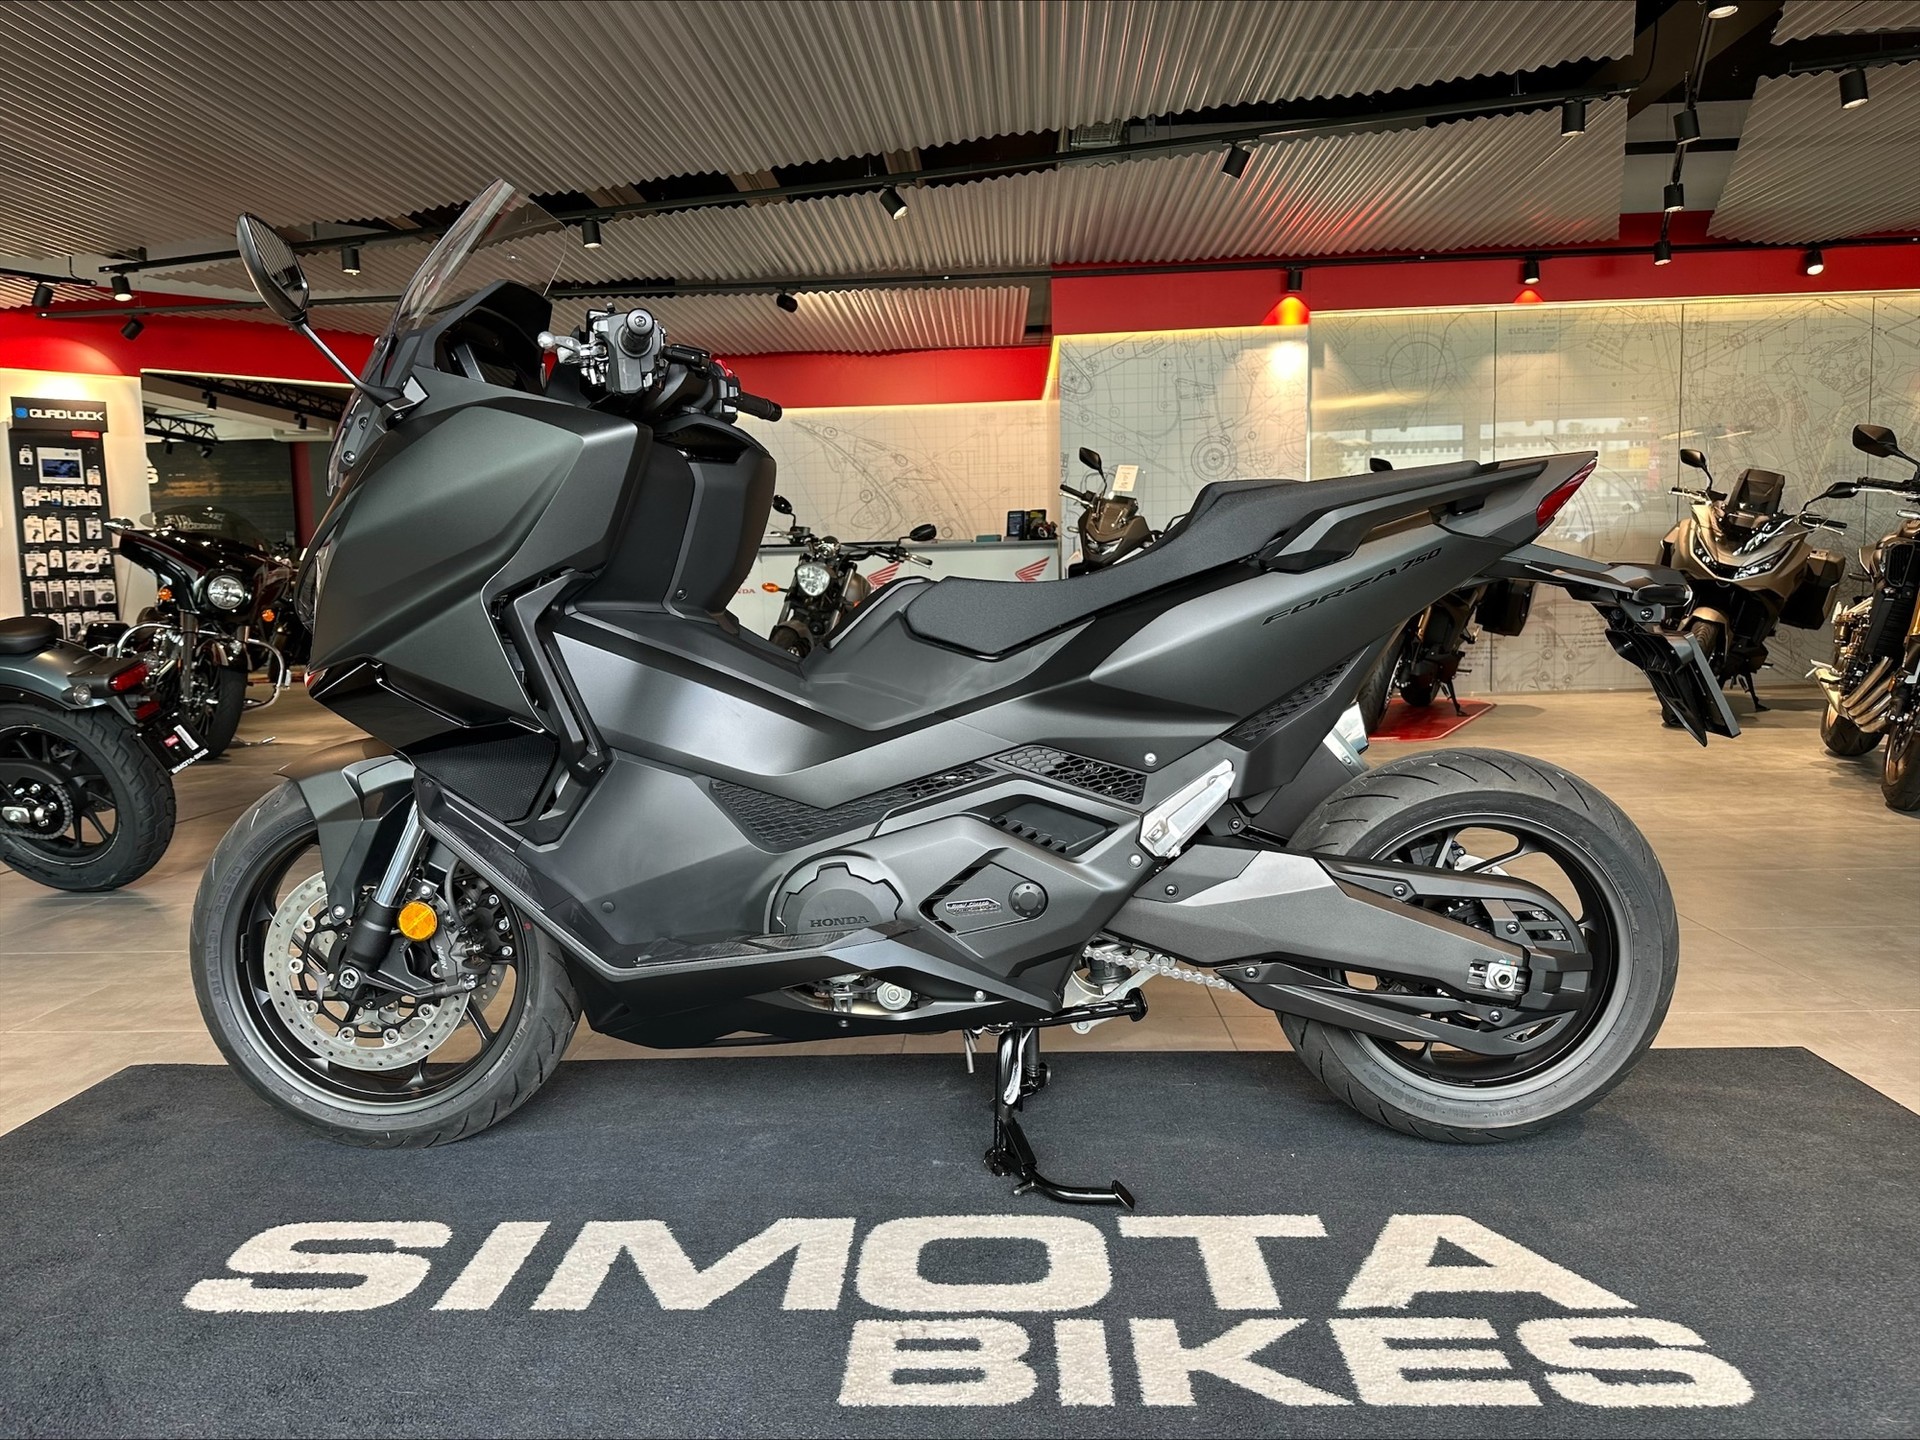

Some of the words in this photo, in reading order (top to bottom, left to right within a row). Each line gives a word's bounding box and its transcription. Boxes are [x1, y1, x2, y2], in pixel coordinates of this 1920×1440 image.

[1262, 567, 1397, 625] FORZA
[1400, 547, 1442, 571] 750
[810, 915, 870, 928] HONDA
[183, 1214, 1637, 1314] SIMOTA
[837, 1316, 1755, 1408] BIKES
